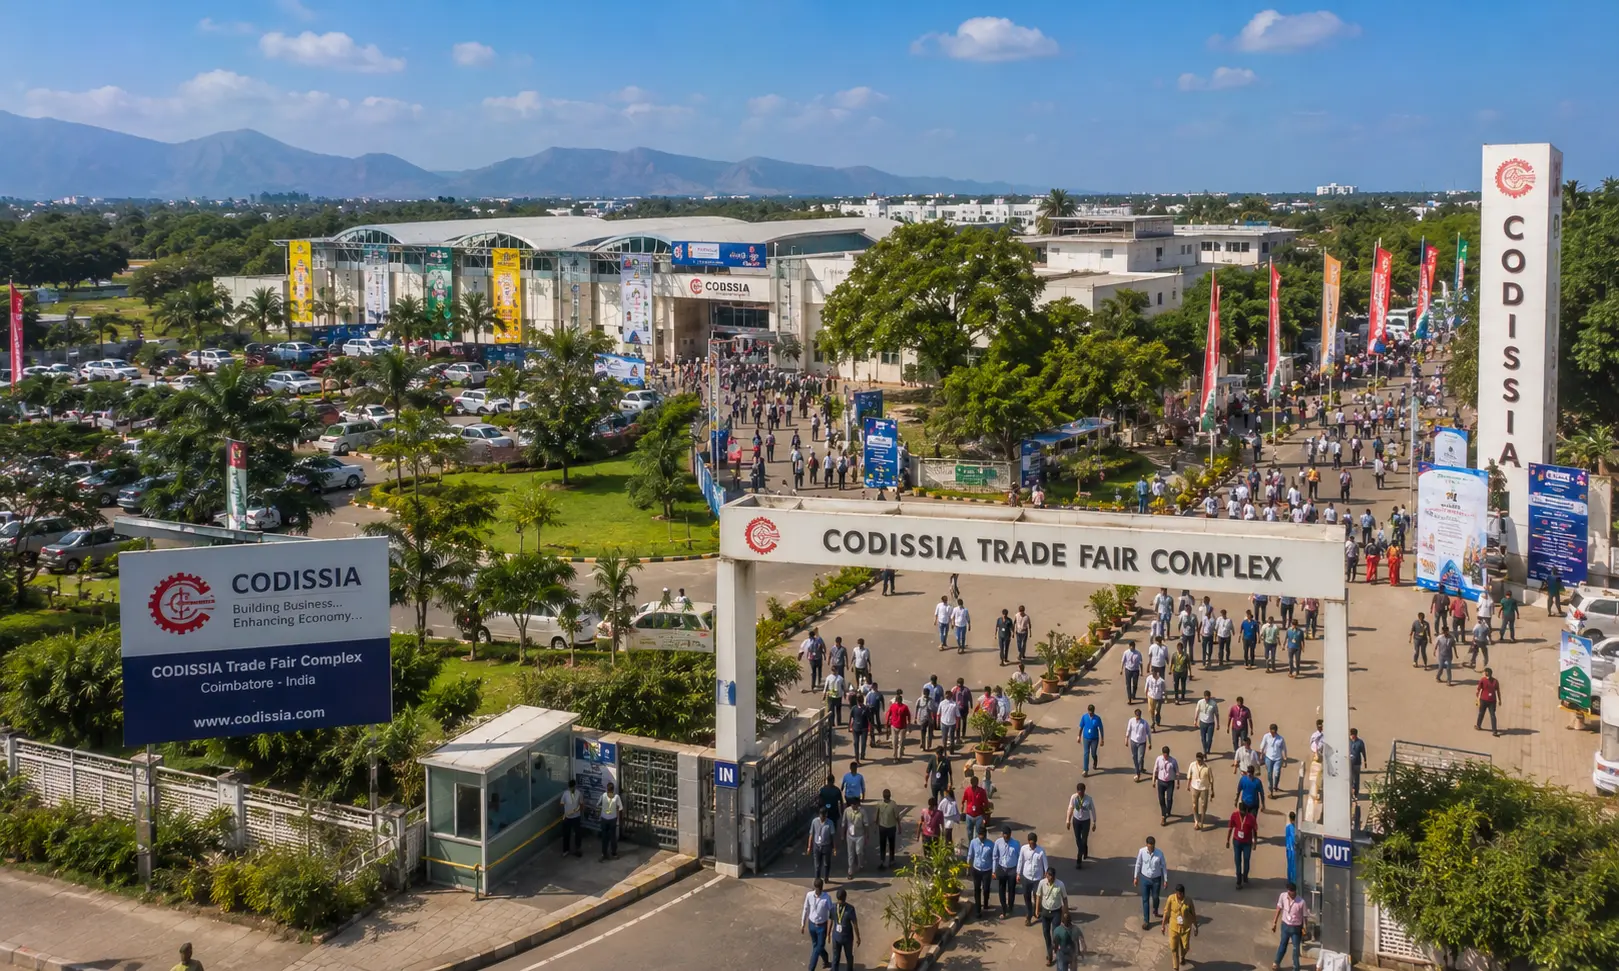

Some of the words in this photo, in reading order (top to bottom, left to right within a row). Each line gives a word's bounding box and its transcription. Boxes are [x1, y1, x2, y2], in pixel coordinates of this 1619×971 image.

[1500, 215, 1527, 469] CODISSIA
[823, 528, 968, 562] CODISSIA
[977, 538, 1068, 568] TRADE
[1079, 544, 1140, 573] FAIR
[1150, 548, 1284, 582] COMPLEX
[231, 566, 362, 595] CODISSIA
[233, 602, 280, 615] Building
[284, 600, 343, 612] Business...
[233, 615, 295, 629] Enhancing
[299, 611, 363, 625] Economy...
[151, 662, 223, 679] CODISSIA
[226, 658, 266, 674] Trade
[270, 656, 297, 670] Fair
[301, 651, 363, 668] Complex
[200, 678, 274, 694] Coimbatore
[286, 674, 316, 688] India
[193, 707, 325, 728] www.codissia.com
[719, 767, 734, 783] IN
[1324, 844, 1350, 862] OUT
